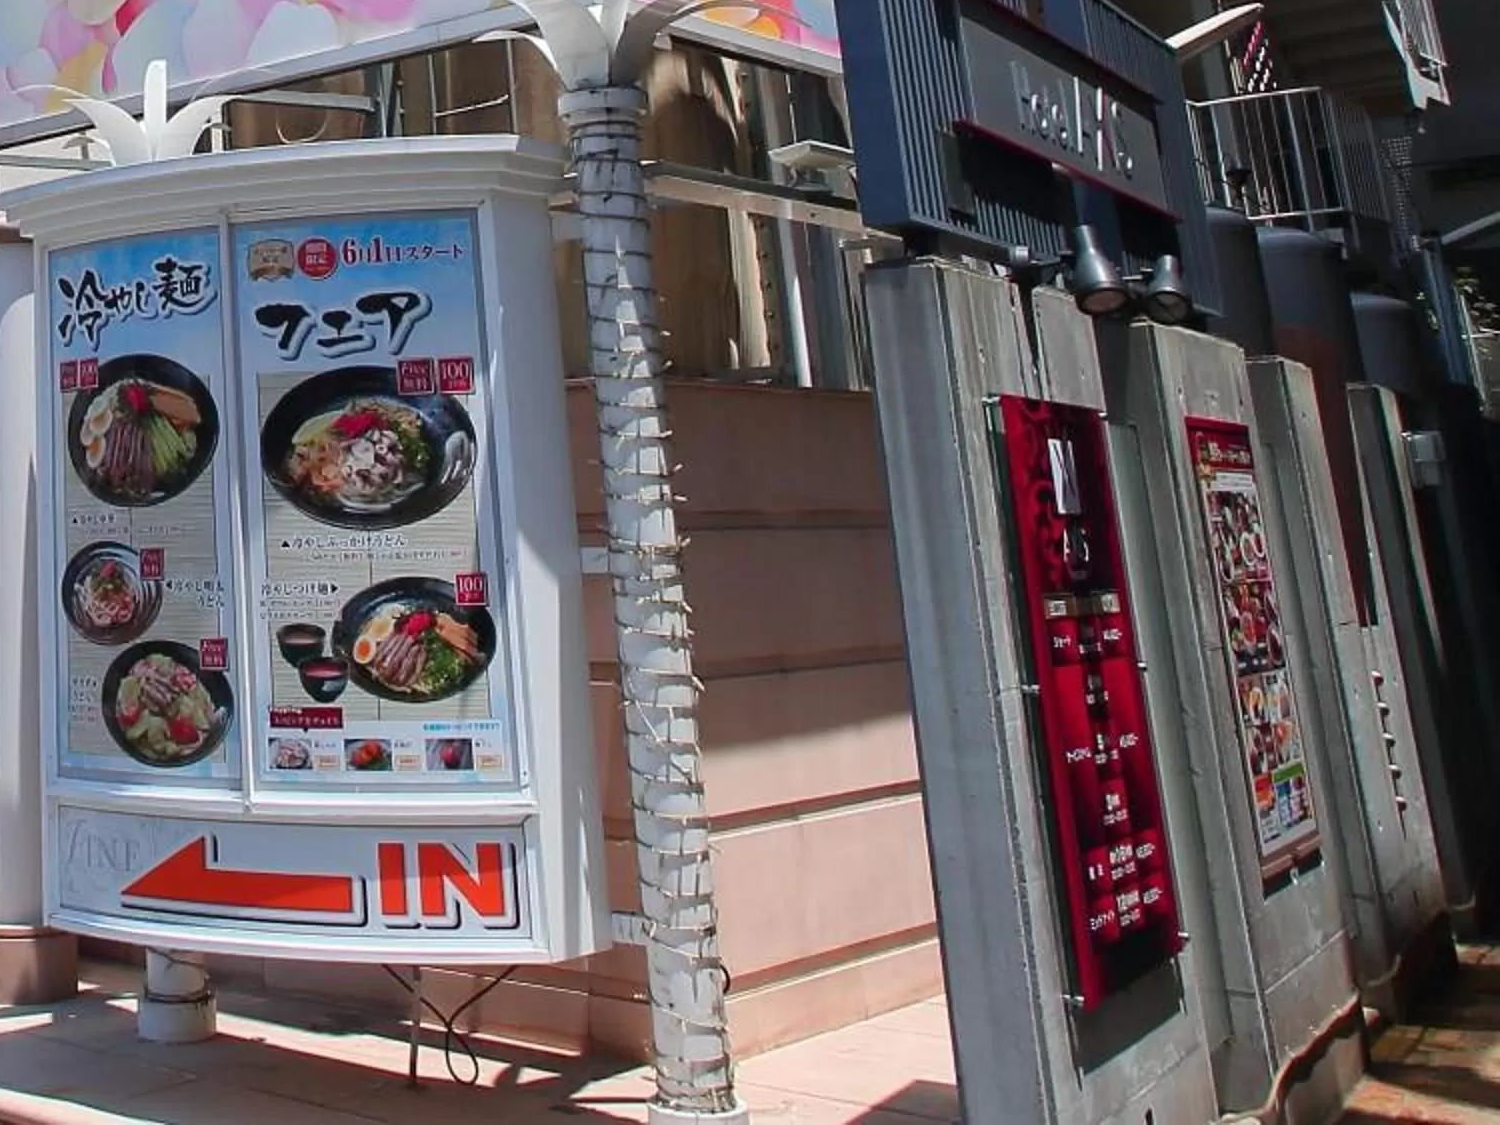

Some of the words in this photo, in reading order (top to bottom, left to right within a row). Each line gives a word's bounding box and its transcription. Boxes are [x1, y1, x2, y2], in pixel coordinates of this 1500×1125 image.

[56, 256, 218, 342] 冷やし麺
[377, 842, 512, 923] IN
